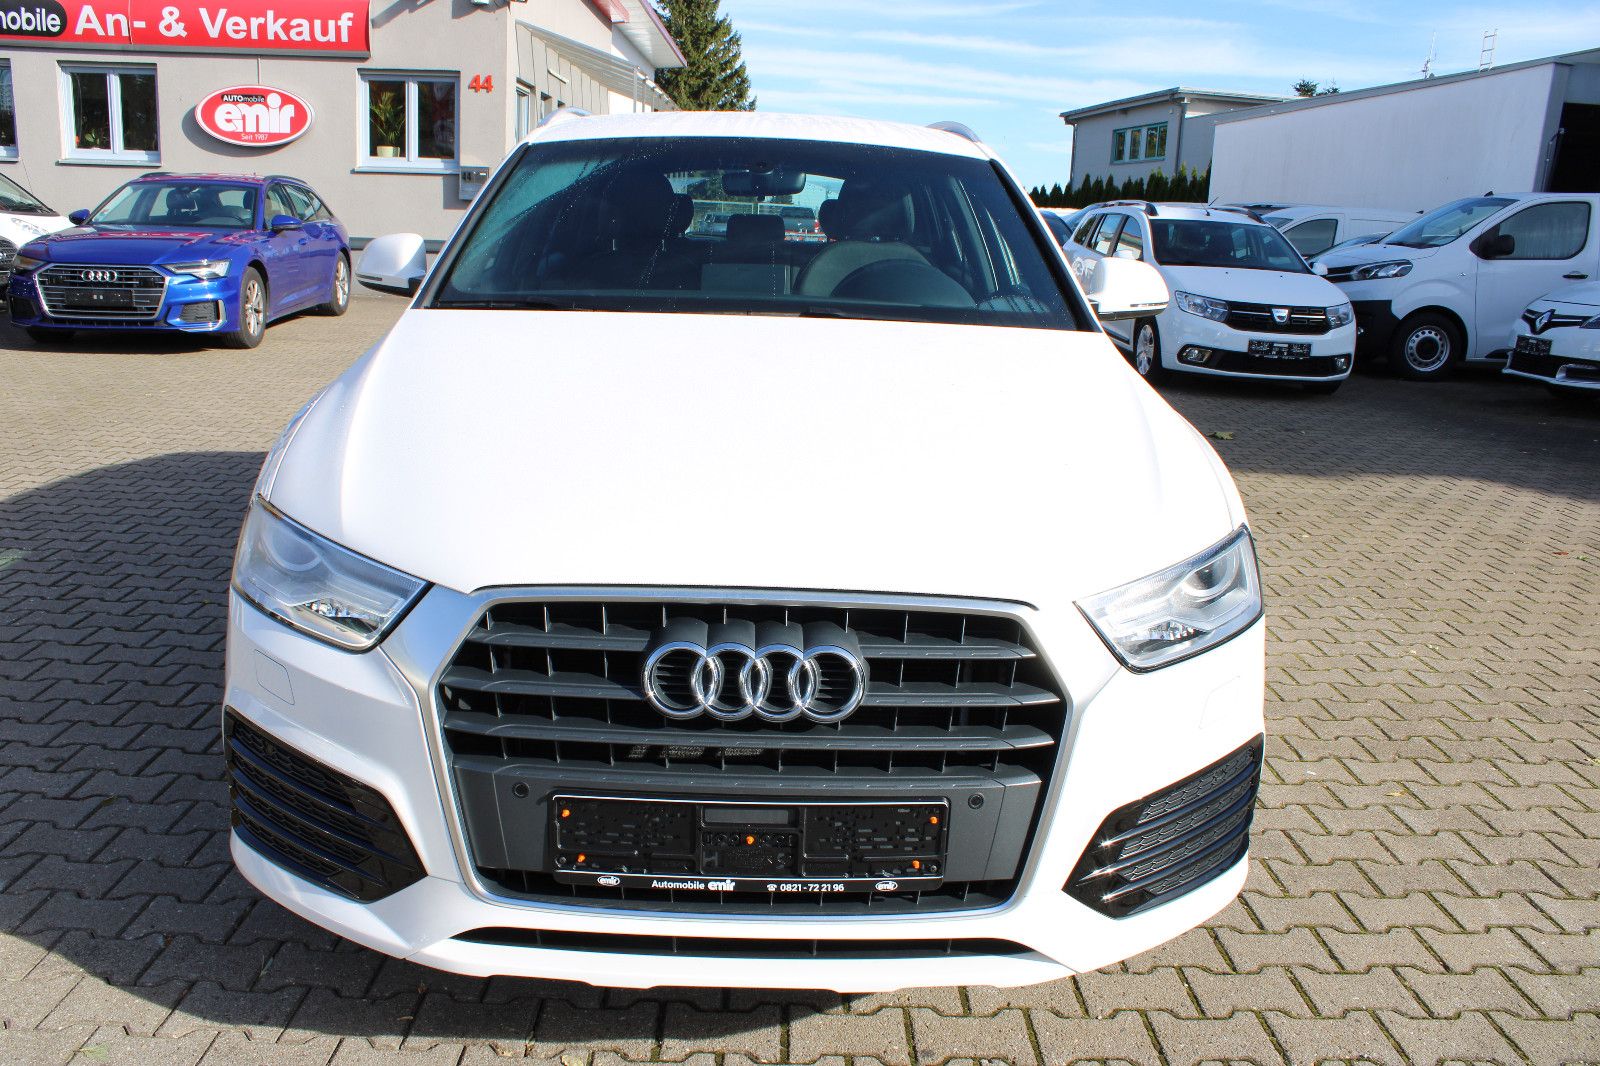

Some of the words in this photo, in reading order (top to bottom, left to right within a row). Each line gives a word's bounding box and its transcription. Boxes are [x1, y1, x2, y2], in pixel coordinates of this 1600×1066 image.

[158, 6, 188, 38] &
[199, 8, 354, 43] Verkauf
[468, 74, 493, 93] 44
[222, 94, 265, 103] AUTOmobile
[214, 93, 295, 133] emir
[241, 133, 253, 141] Seit
[599, 876, 618, 886] emir
[651, 879, 705, 890] Automobile
[707, 879, 736, 891] emir
